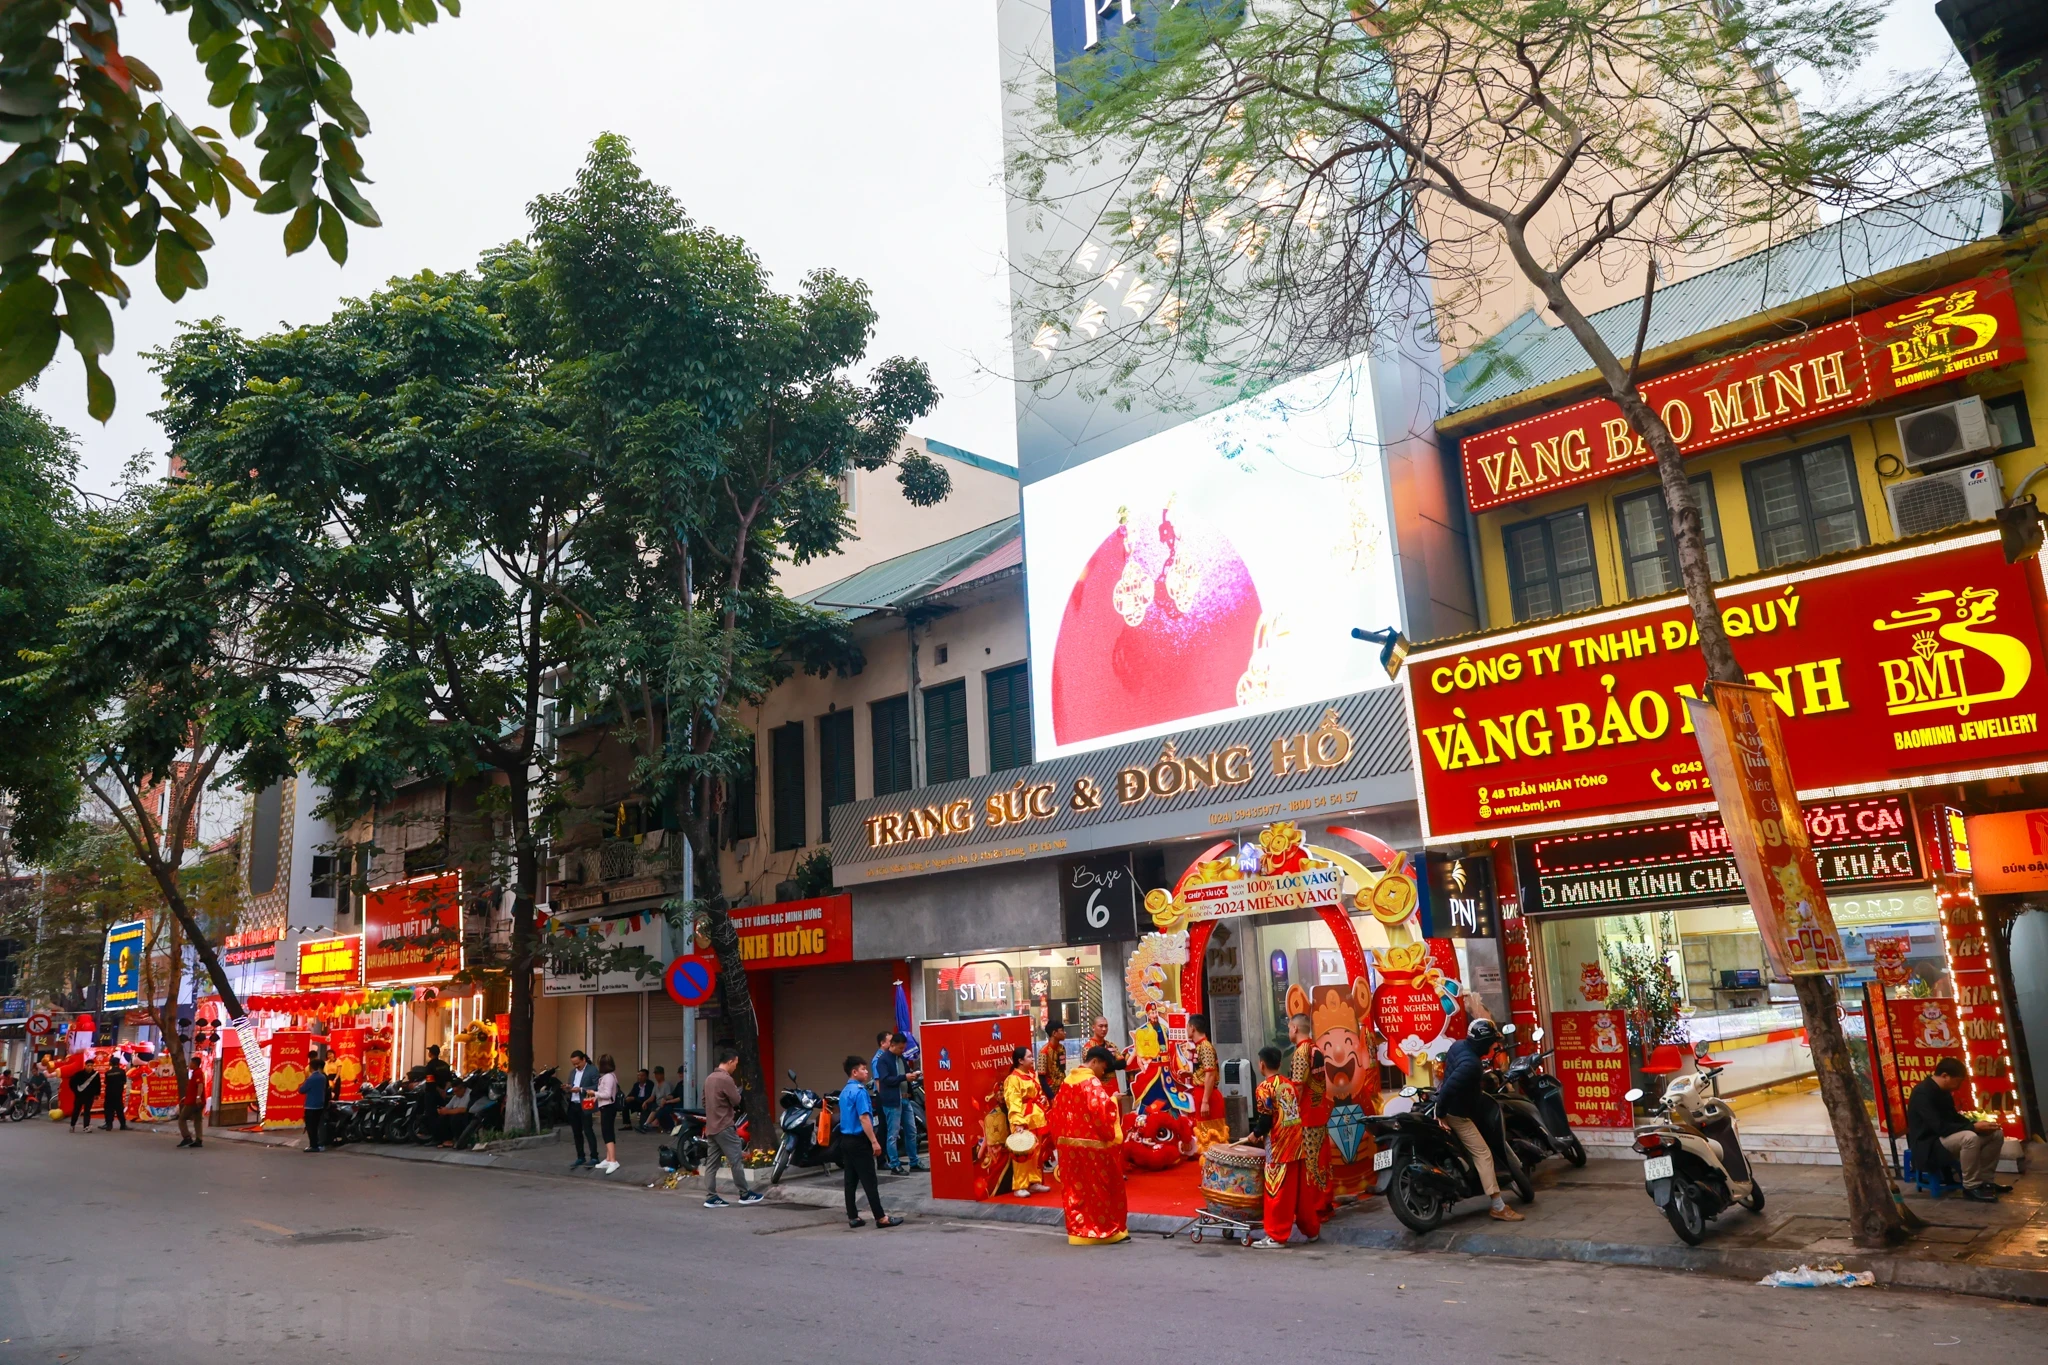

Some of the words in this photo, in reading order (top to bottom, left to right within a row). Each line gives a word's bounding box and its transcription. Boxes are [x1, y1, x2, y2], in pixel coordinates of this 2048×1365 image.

[1477, 435, 1592, 496] VÀNG
[1601, 391, 1693, 465] BO
[1709, 350, 1852, 434] MINH
[1431, 652, 1522, 694] CÔNG
[1528, 643, 1562, 676] TY
[1569, 625, 1657, 667] TNHH
[1721, 585, 1801, 638] QUÝ
[1422, 706, 1553, 771] VÀNG
[1556, 674, 1669, 752] BẢO
[1673, 656, 1850, 735] MNH
[1893, 725, 1957, 750] BAOMINH
[1958, 713, 2038, 742] JEWELLERY
[864, 797, 975, 849] TRANG
[985, 779, 1060, 827] SỨC
[1069, 776, 1101, 811] &
[1116, 741, 1254, 805] ĐỒNG
[1271, 708, 1354, 778] HỒ
[1675, 779, 1697, 792] 091
[1491, 789, 1506, 799] 4B
[1507, 781, 1536, 797] TRẦN
[1539, 778, 1572, 794] NHÂN
[1574, 774, 1608, 789] TÔNG
[1208, 811, 1232, 826] (024)
[1313, 795, 1327, 810] 54
[1329, 793, 1343, 807] 54
[1345, 790, 1359, 804] 57
[1493, 799, 1561, 816] www.bmj.vn
[1240, 858, 1257, 872] PNJ
[2002, 863, 2026, 874] BÚN
[1071, 864, 1122, 890] Base
[1247, 879, 1275, 893] 100%
[1276, 875, 1301, 890] LỘC
[1302, 870, 1338, 886] VÀNG
[1561, 878, 1622, 903] MINH
[1627, 869, 1683, 897] KÍNH
[1690, 861, 1743, 890] CHÀ
[1833, 847, 1914, 877] KHÁC
[1204, 889, 1214, 898] TÀI
[1214, 888, 1226, 897] LỘC
[1085, 888, 1110, 929] 6
[1214, 901, 1246, 916] 2024
[1247, 893, 1295, 911] MIẾNG
[1297, 887, 1338, 904] VÀNG
[744, 916, 752, 928] TY
[753, 913, 770, 927] VÀNG
[771, 912, 785, 927] BẠC
[785, 909, 803, 923] MINH
[1449, 898, 1477, 933] PNJ
[773, 925, 826, 957] HƯNG
[960, 981, 1007, 1001] STYLE
[1408, 993, 1433, 1003] XUÂN
[1381, 994, 1397, 1005] TẾT
[1381, 1005, 1399, 1014] ĐÓN
[1403, 1003, 1440, 1013] NGHÊNH
[1379, 1013, 1403, 1024] THẦN
[1413, 1013, 1431, 1022] KIM
[1385, 1024, 1399, 1033] TÀI
[1415, 1022, 1432, 1032] LỘC
[280, 1047, 300, 1055] 2024
[939, 1060, 951, 1070] PNJ
[1562, 1056, 1593, 1070] ĐIỂM
[1596, 1058, 1622, 1070] BÁN
[1576, 1070, 1609, 1082] VÀNG
[1577, 1085, 1610, 1098] 9999
[937, 1096, 958, 1109] BÁN
[935, 1113, 963, 1127] VÀNG
[936, 1131, 965, 1148] THẦN
[944, 1149, 961, 1166] TÀI
